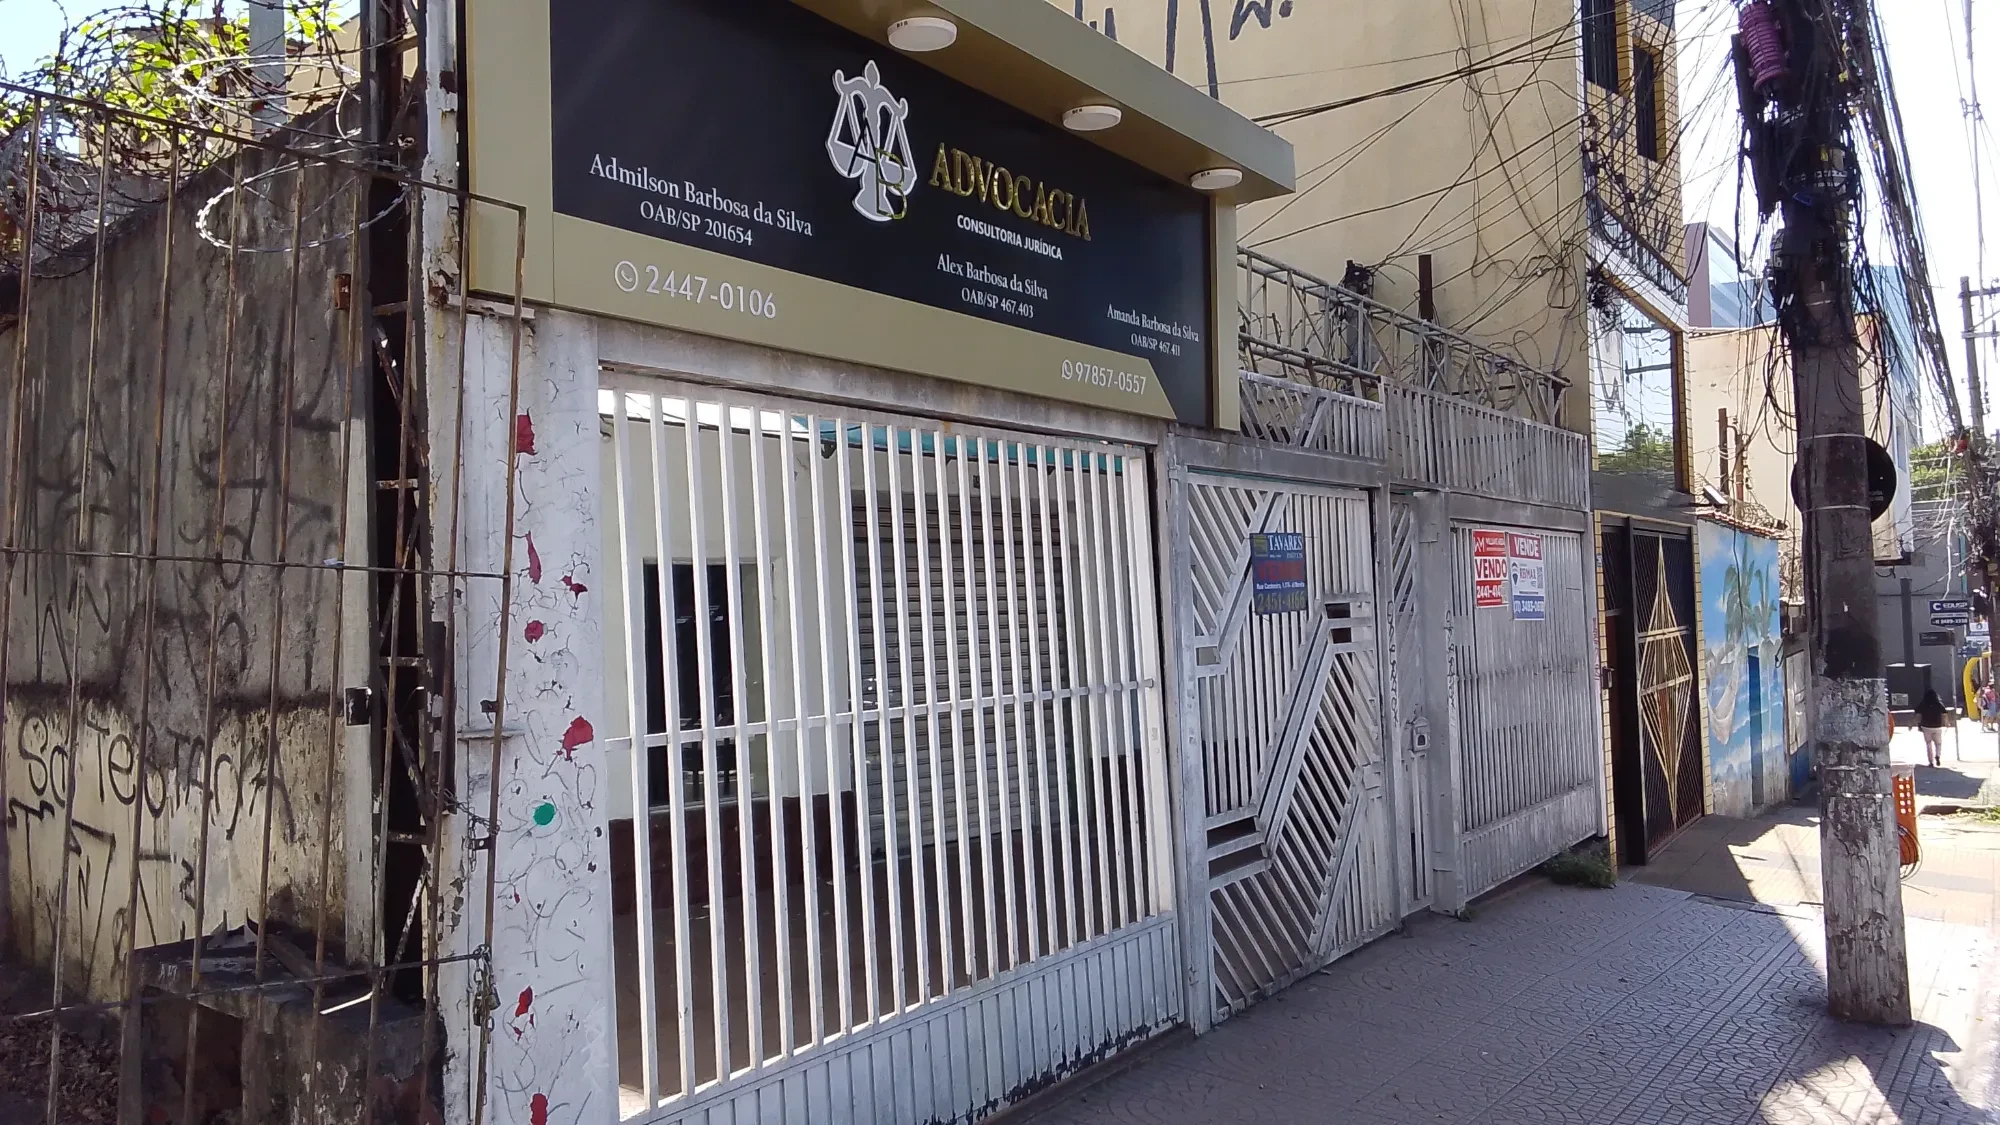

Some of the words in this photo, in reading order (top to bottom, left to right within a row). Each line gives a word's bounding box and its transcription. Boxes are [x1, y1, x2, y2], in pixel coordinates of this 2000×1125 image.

[589, 153, 680, 199] Admilson
[684, 181, 750, 220] Barbosa
[753, 202, 773, 225] da
[776, 209, 813, 237] Silva
[928, 142, 1091, 241] ADVOCACIA
[640, 200, 701, 233] OAB/SP
[704, 218, 753, 246] 201654
[957, 214, 1022, 248] CONSULTORIA
[1024, 238, 1063, 260] JURÍDICA
[645, 265, 777, 319] 2447-0106
[936, 253, 964, 277] Alex
[966, 261, 1009, 289] Barbosa
[1010, 273, 1023, 293] da
[1024, 278, 1048, 300] Silva
[961, 287, 999, 309] OAB/SP
[1000, 297, 1034, 319] 467.403
[1107, 303, 1141, 327] Amanda
[1141, 313, 1172, 335] Barbosa
[1172, 321, 1182, 338] da
[1182, 325, 1200, 343] Silva
[1131, 333, 1158, 350] OAB/SP
[1158, 343, 1181, 357] 467.411
[1075, 361, 1147, 395] 97857-0557
[1268, 534, 1303, 551] TAVARES
[1513, 536, 1540, 558] VENDE
[1474, 557, 1508, 579] VENDO
